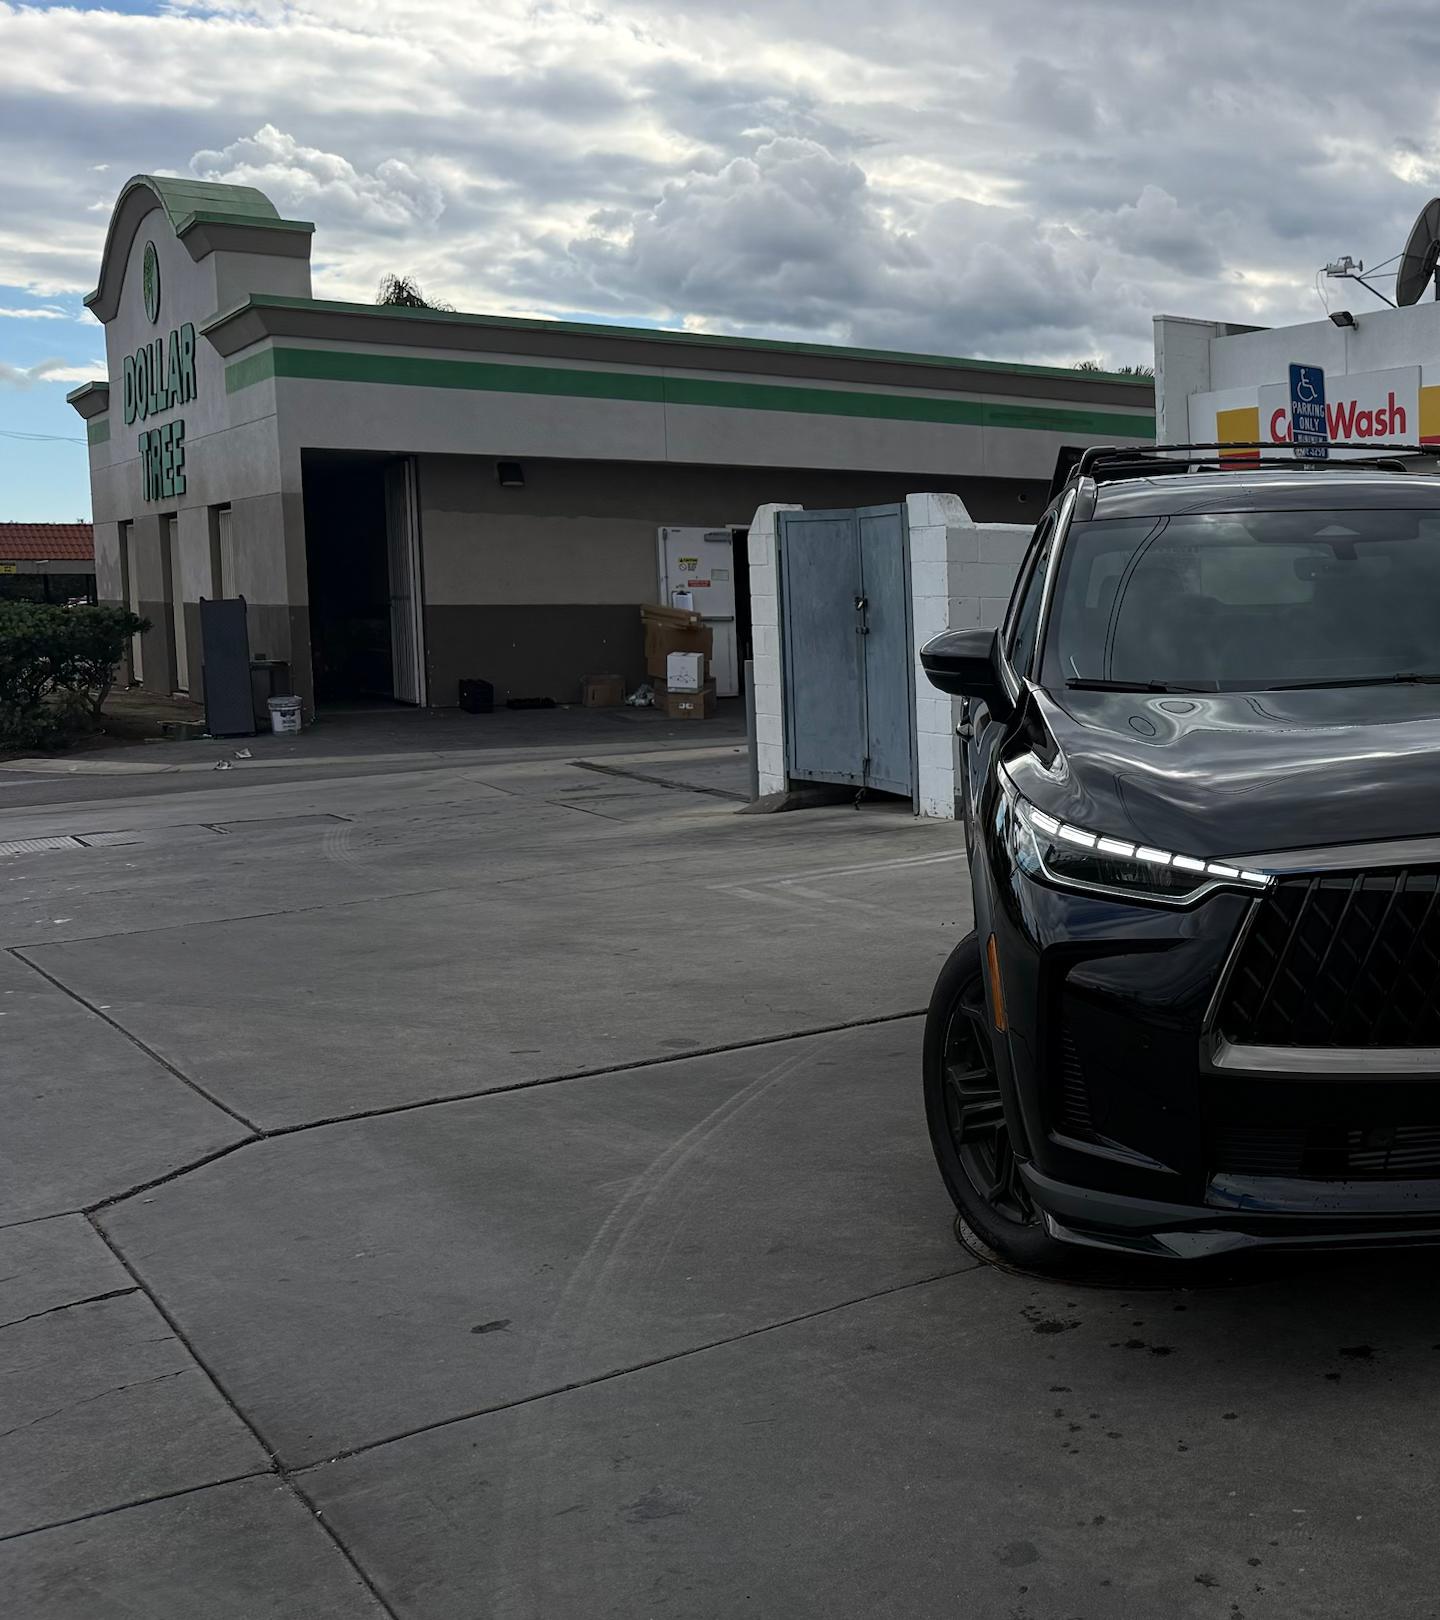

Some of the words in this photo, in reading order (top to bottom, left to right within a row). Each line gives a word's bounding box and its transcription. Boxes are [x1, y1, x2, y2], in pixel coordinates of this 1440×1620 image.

[124, 322, 197, 425] DOLLAR
[1292, 401, 1325, 418] PARKING
[1299, 416, 1320, 431] ONLY
[1327, 392, 1406, 440] Wash
[138, 419, 186, 501] TREE
